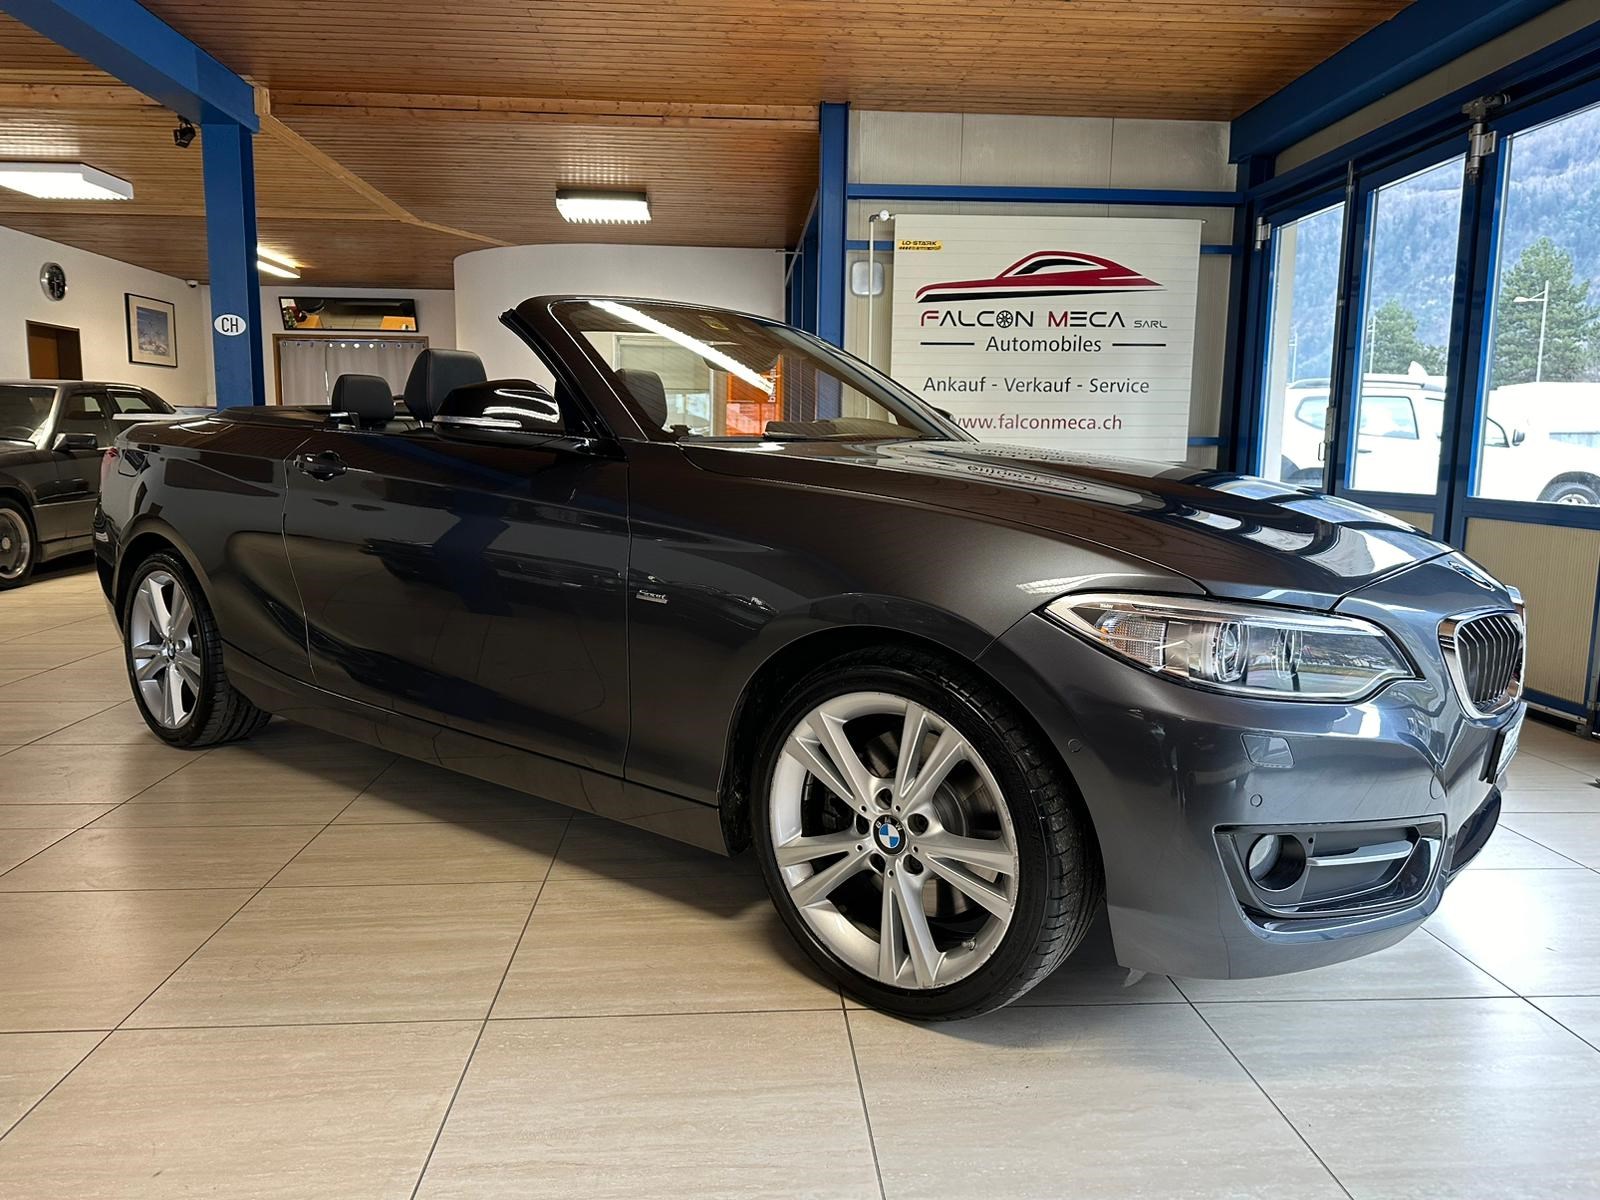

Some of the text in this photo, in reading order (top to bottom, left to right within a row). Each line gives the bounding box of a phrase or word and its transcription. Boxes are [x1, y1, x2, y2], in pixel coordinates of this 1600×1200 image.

[221, 316, 239, 333] CH
[920, 310, 1168, 329] FALCON MECA SARL
[985, 333, 1102, 352] Automobiles
[923, 376, 987, 393] Ankauf
[1004, 377, 1072, 393] Verkauf
[1089, 377, 1150, 393] Service
[957, 413, 1122, 430] ww.falconmeca.ch
[875, 816, 903, 831] BMW
